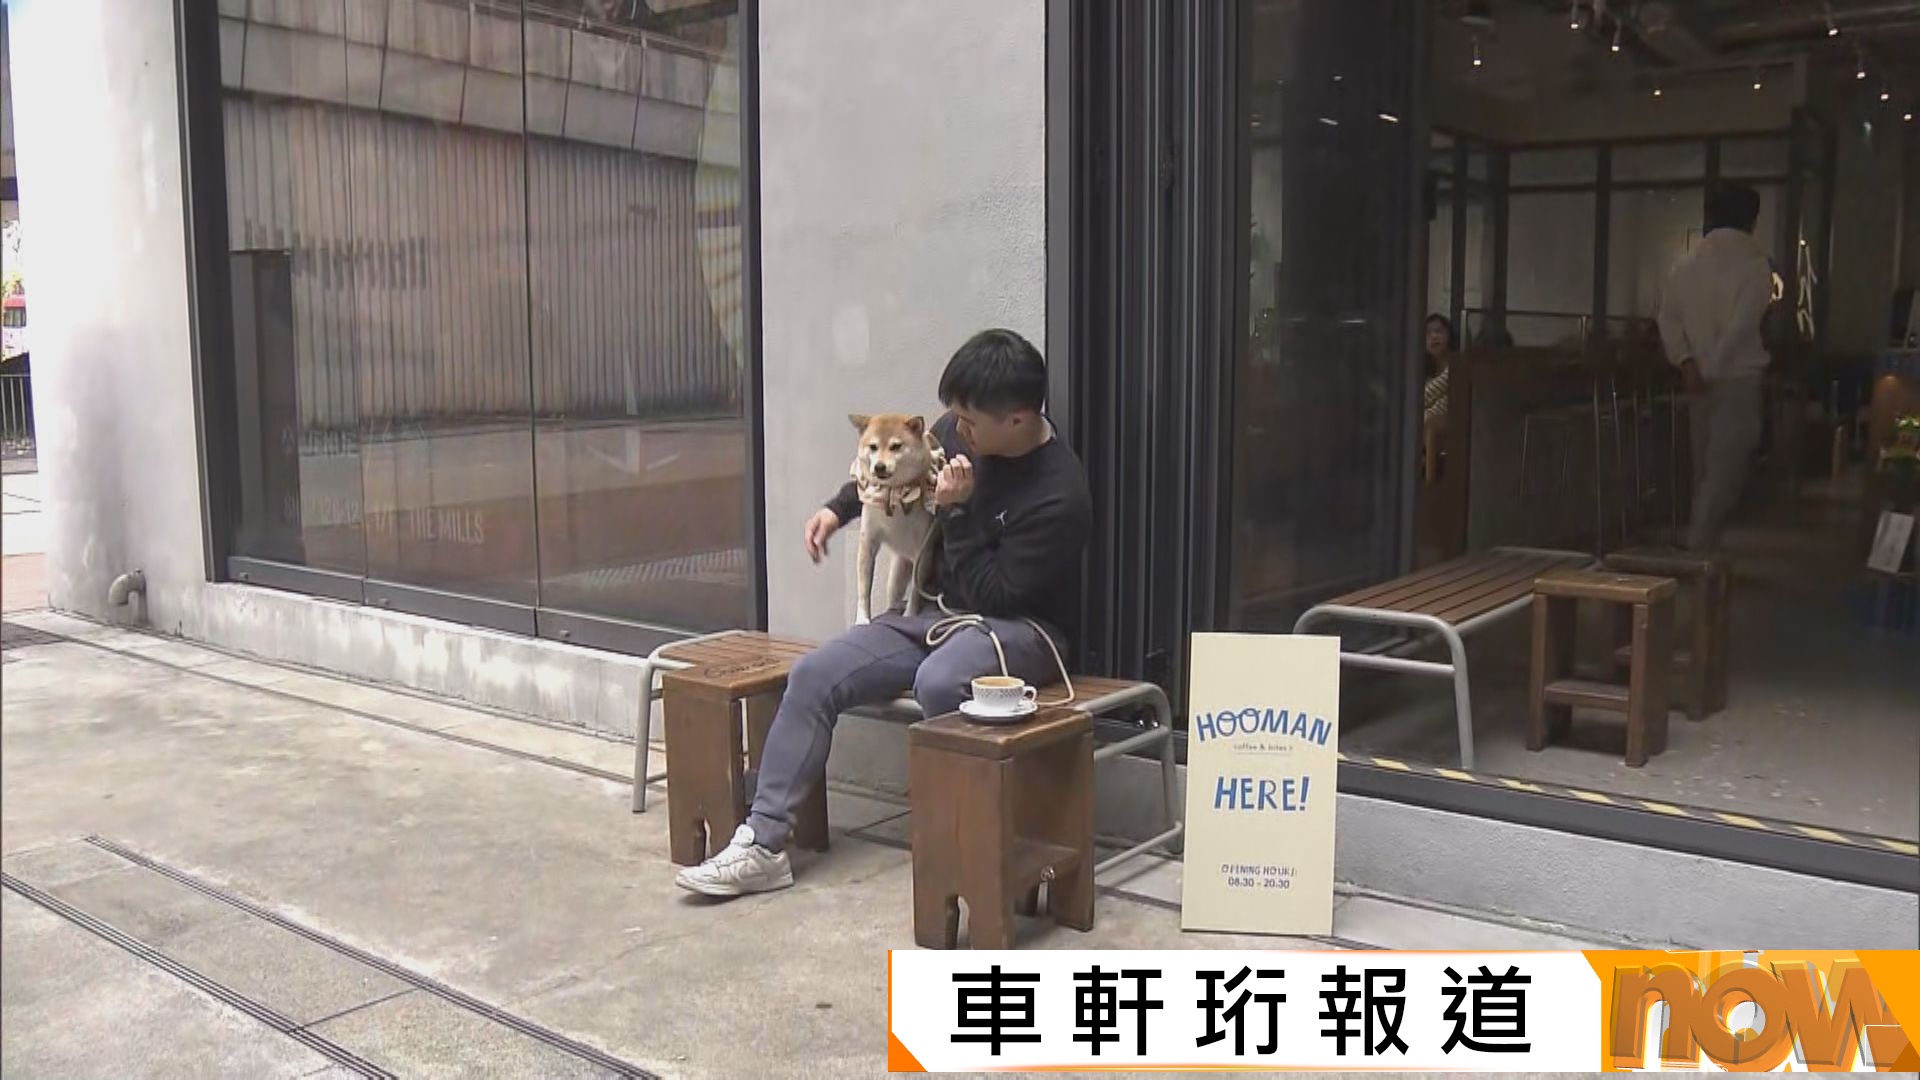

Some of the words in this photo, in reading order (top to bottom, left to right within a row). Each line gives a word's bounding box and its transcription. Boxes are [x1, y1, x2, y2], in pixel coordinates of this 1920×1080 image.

[438, 507, 485, 544] MILLS
[1196, 708, 1332, 745] HOOMAN
[1214, 776, 1310, 811] HERE!
